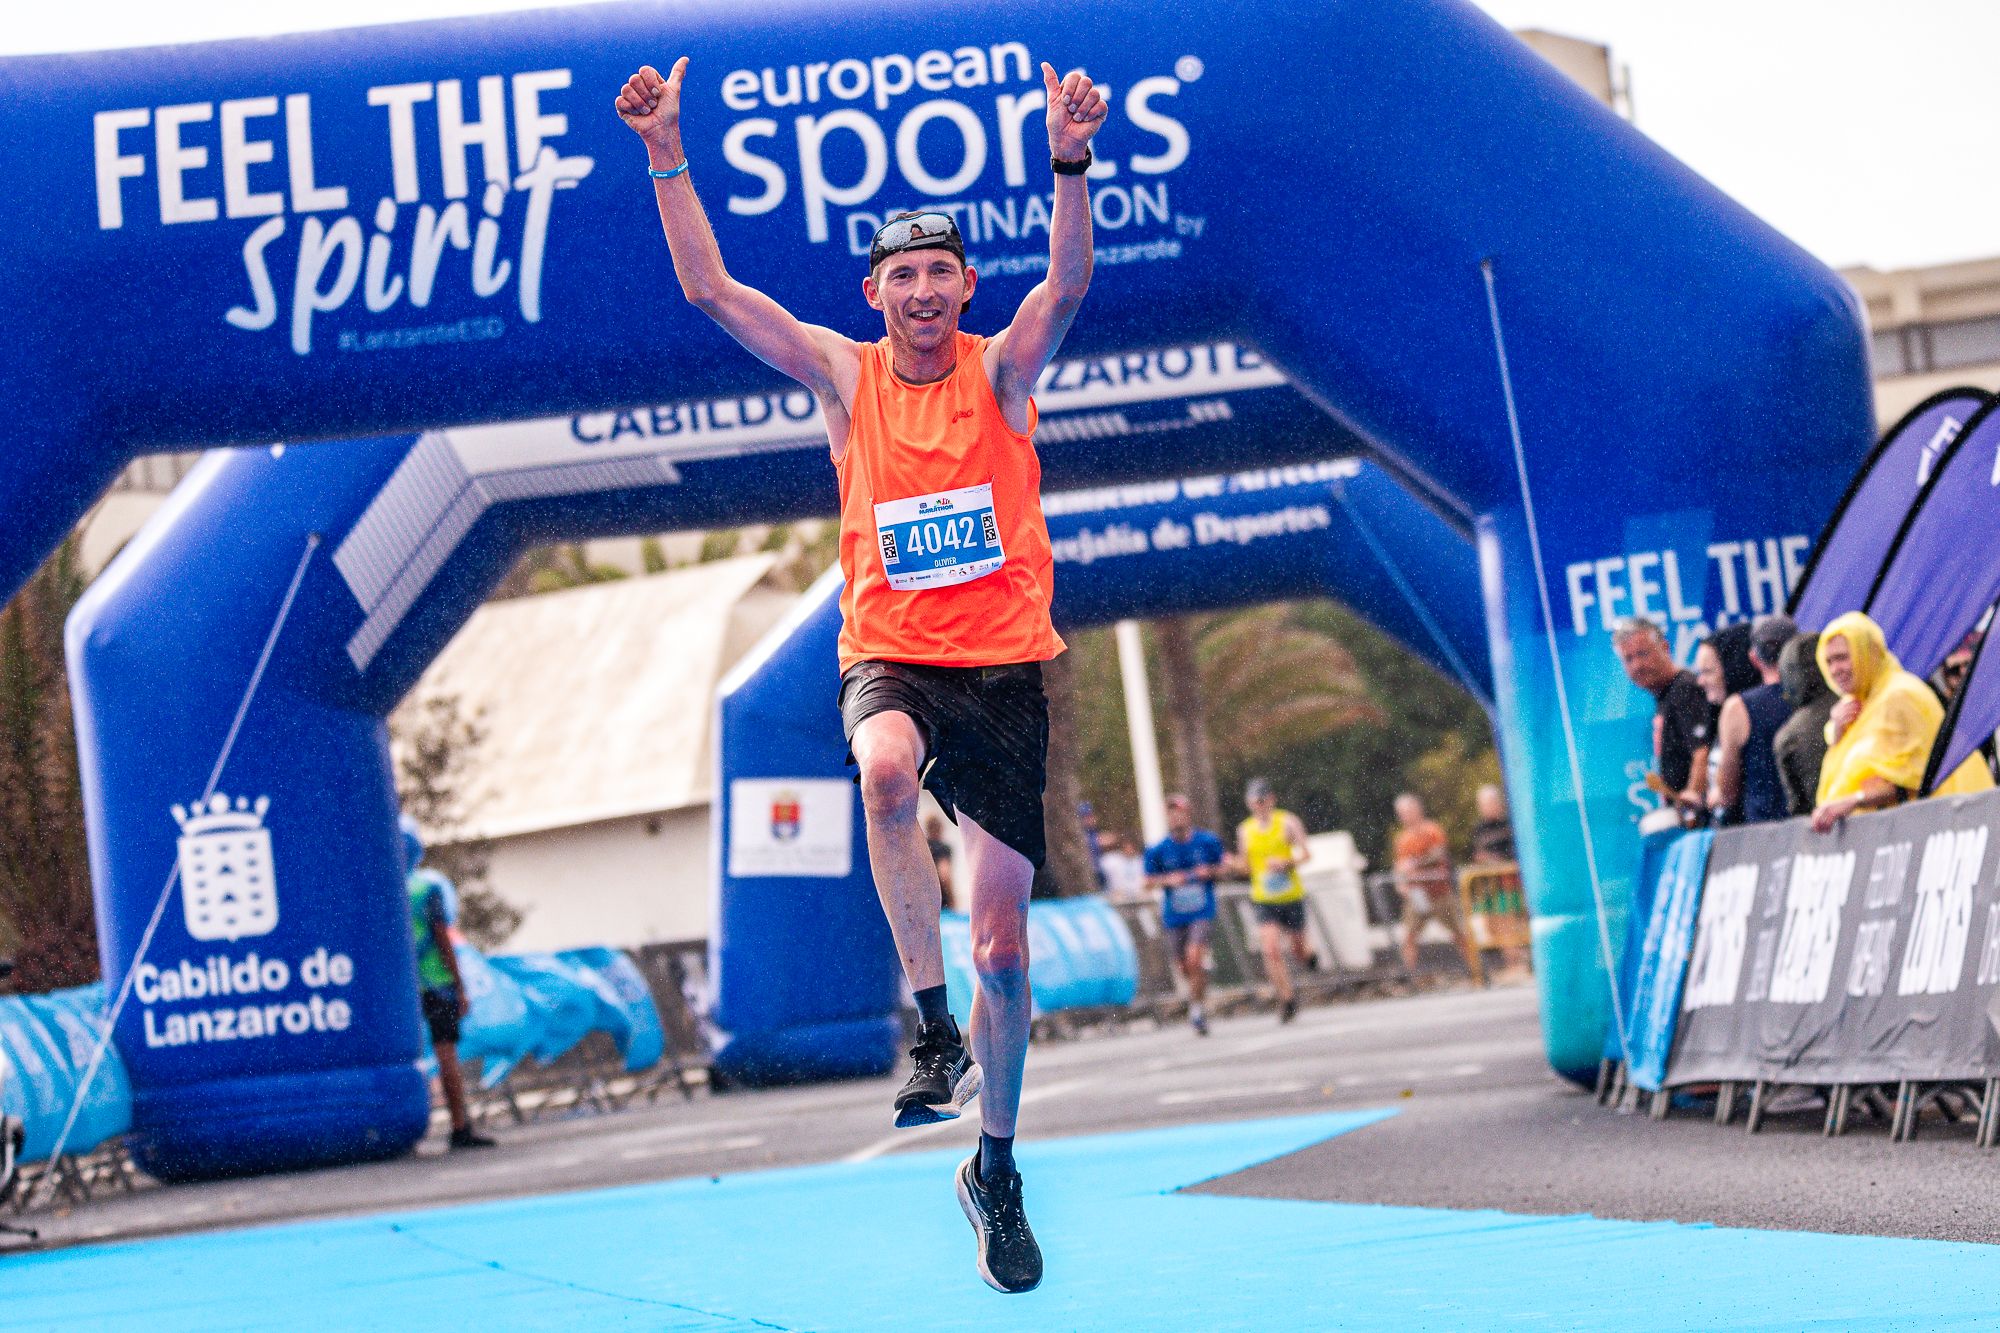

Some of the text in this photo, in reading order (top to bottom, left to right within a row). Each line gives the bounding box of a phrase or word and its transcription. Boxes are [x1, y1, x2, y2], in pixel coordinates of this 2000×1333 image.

[721, 41, 1032, 111] european
[94, 68, 572, 229] FEEL THE
[225, 146, 595, 356] spirit
[569, 391, 816, 444] CABILDO
[907, 516, 978, 556] 4042
[934, 557, 957, 568] OLIVIER
[1566, 535, 1810, 637] FEEL THE
[134, 946, 354, 1004] Cabildo de
[144, 994, 352, 1048] Lanzarote
